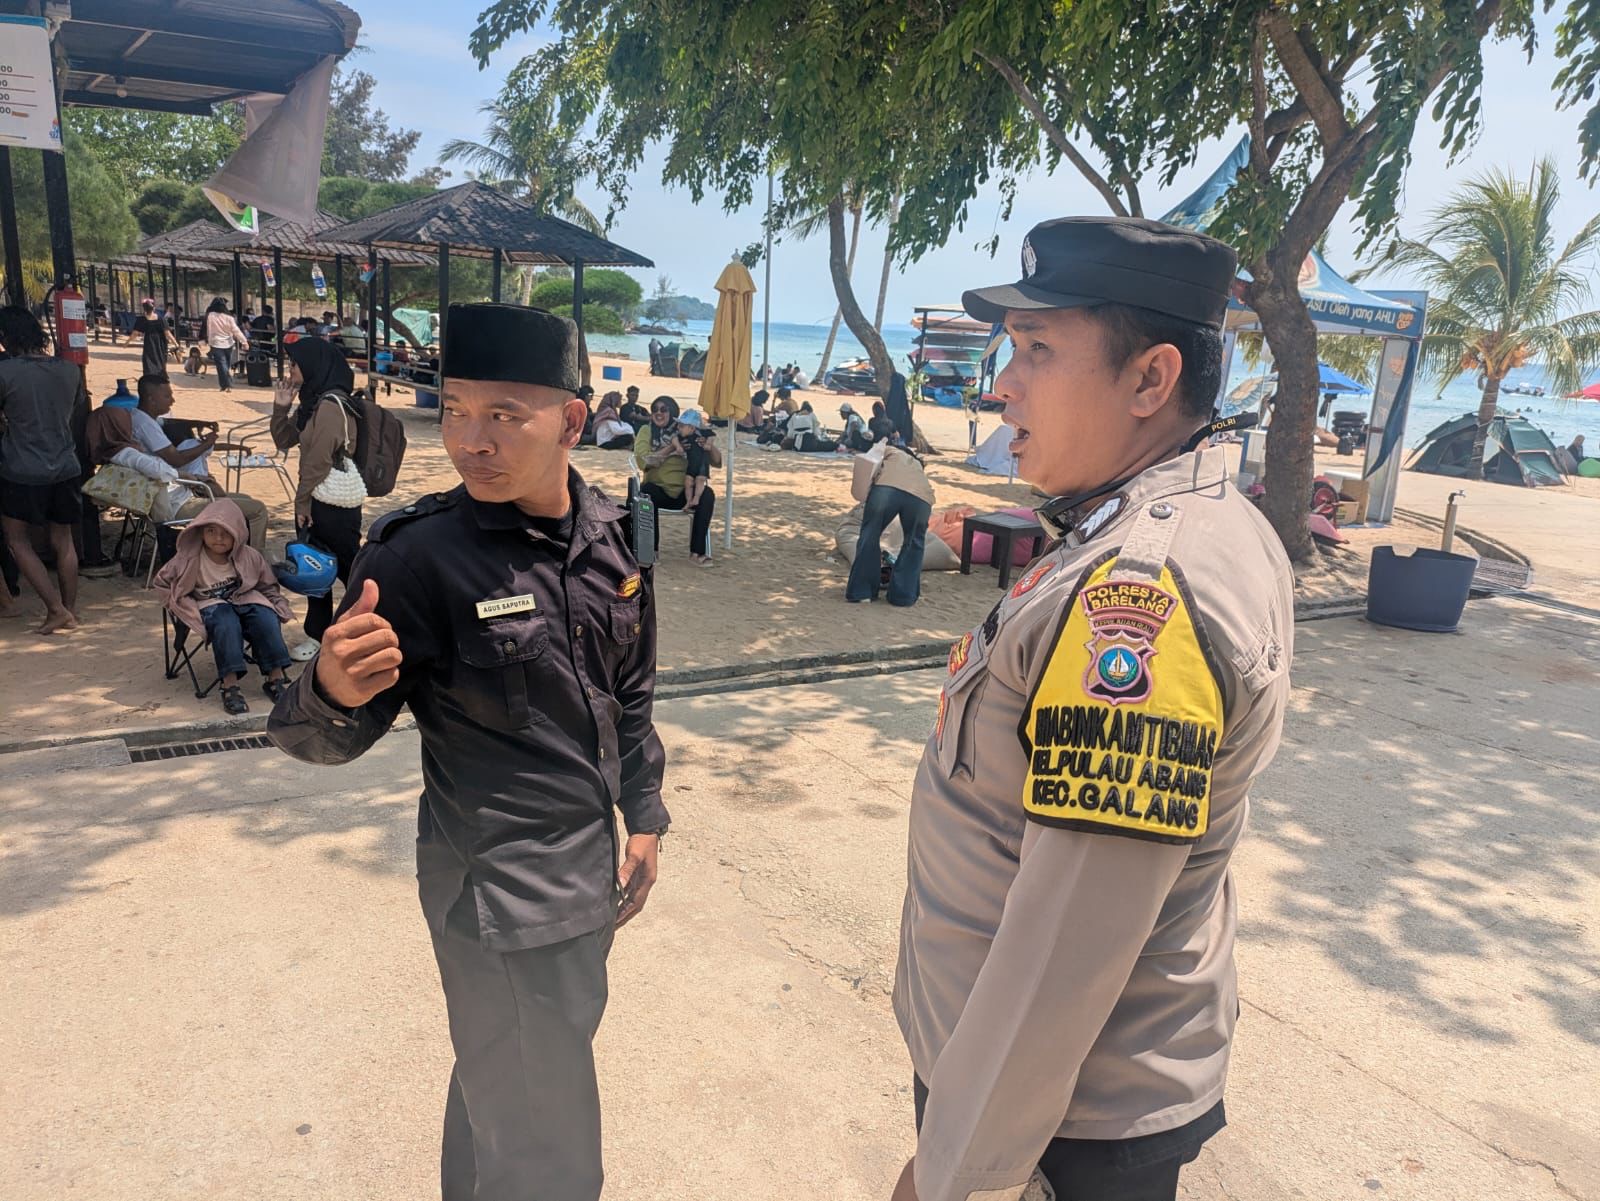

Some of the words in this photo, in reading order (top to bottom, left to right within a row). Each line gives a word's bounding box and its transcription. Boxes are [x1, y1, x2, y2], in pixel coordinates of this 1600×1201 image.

[1350, 306, 1373, 323] yang
[1374, 311, 1395, 324] AHLI
[1211, 417, 1236, 432] POLRI
[1087, 585, 1169, 608] POLRESTA
[1091, 596, 1165, 615] BARELANG
[483, 604, 501, 613] AGUS
[502, 600, 530, 610] SAPUTRA
[1137, 761, 1208, 799] ABANG
